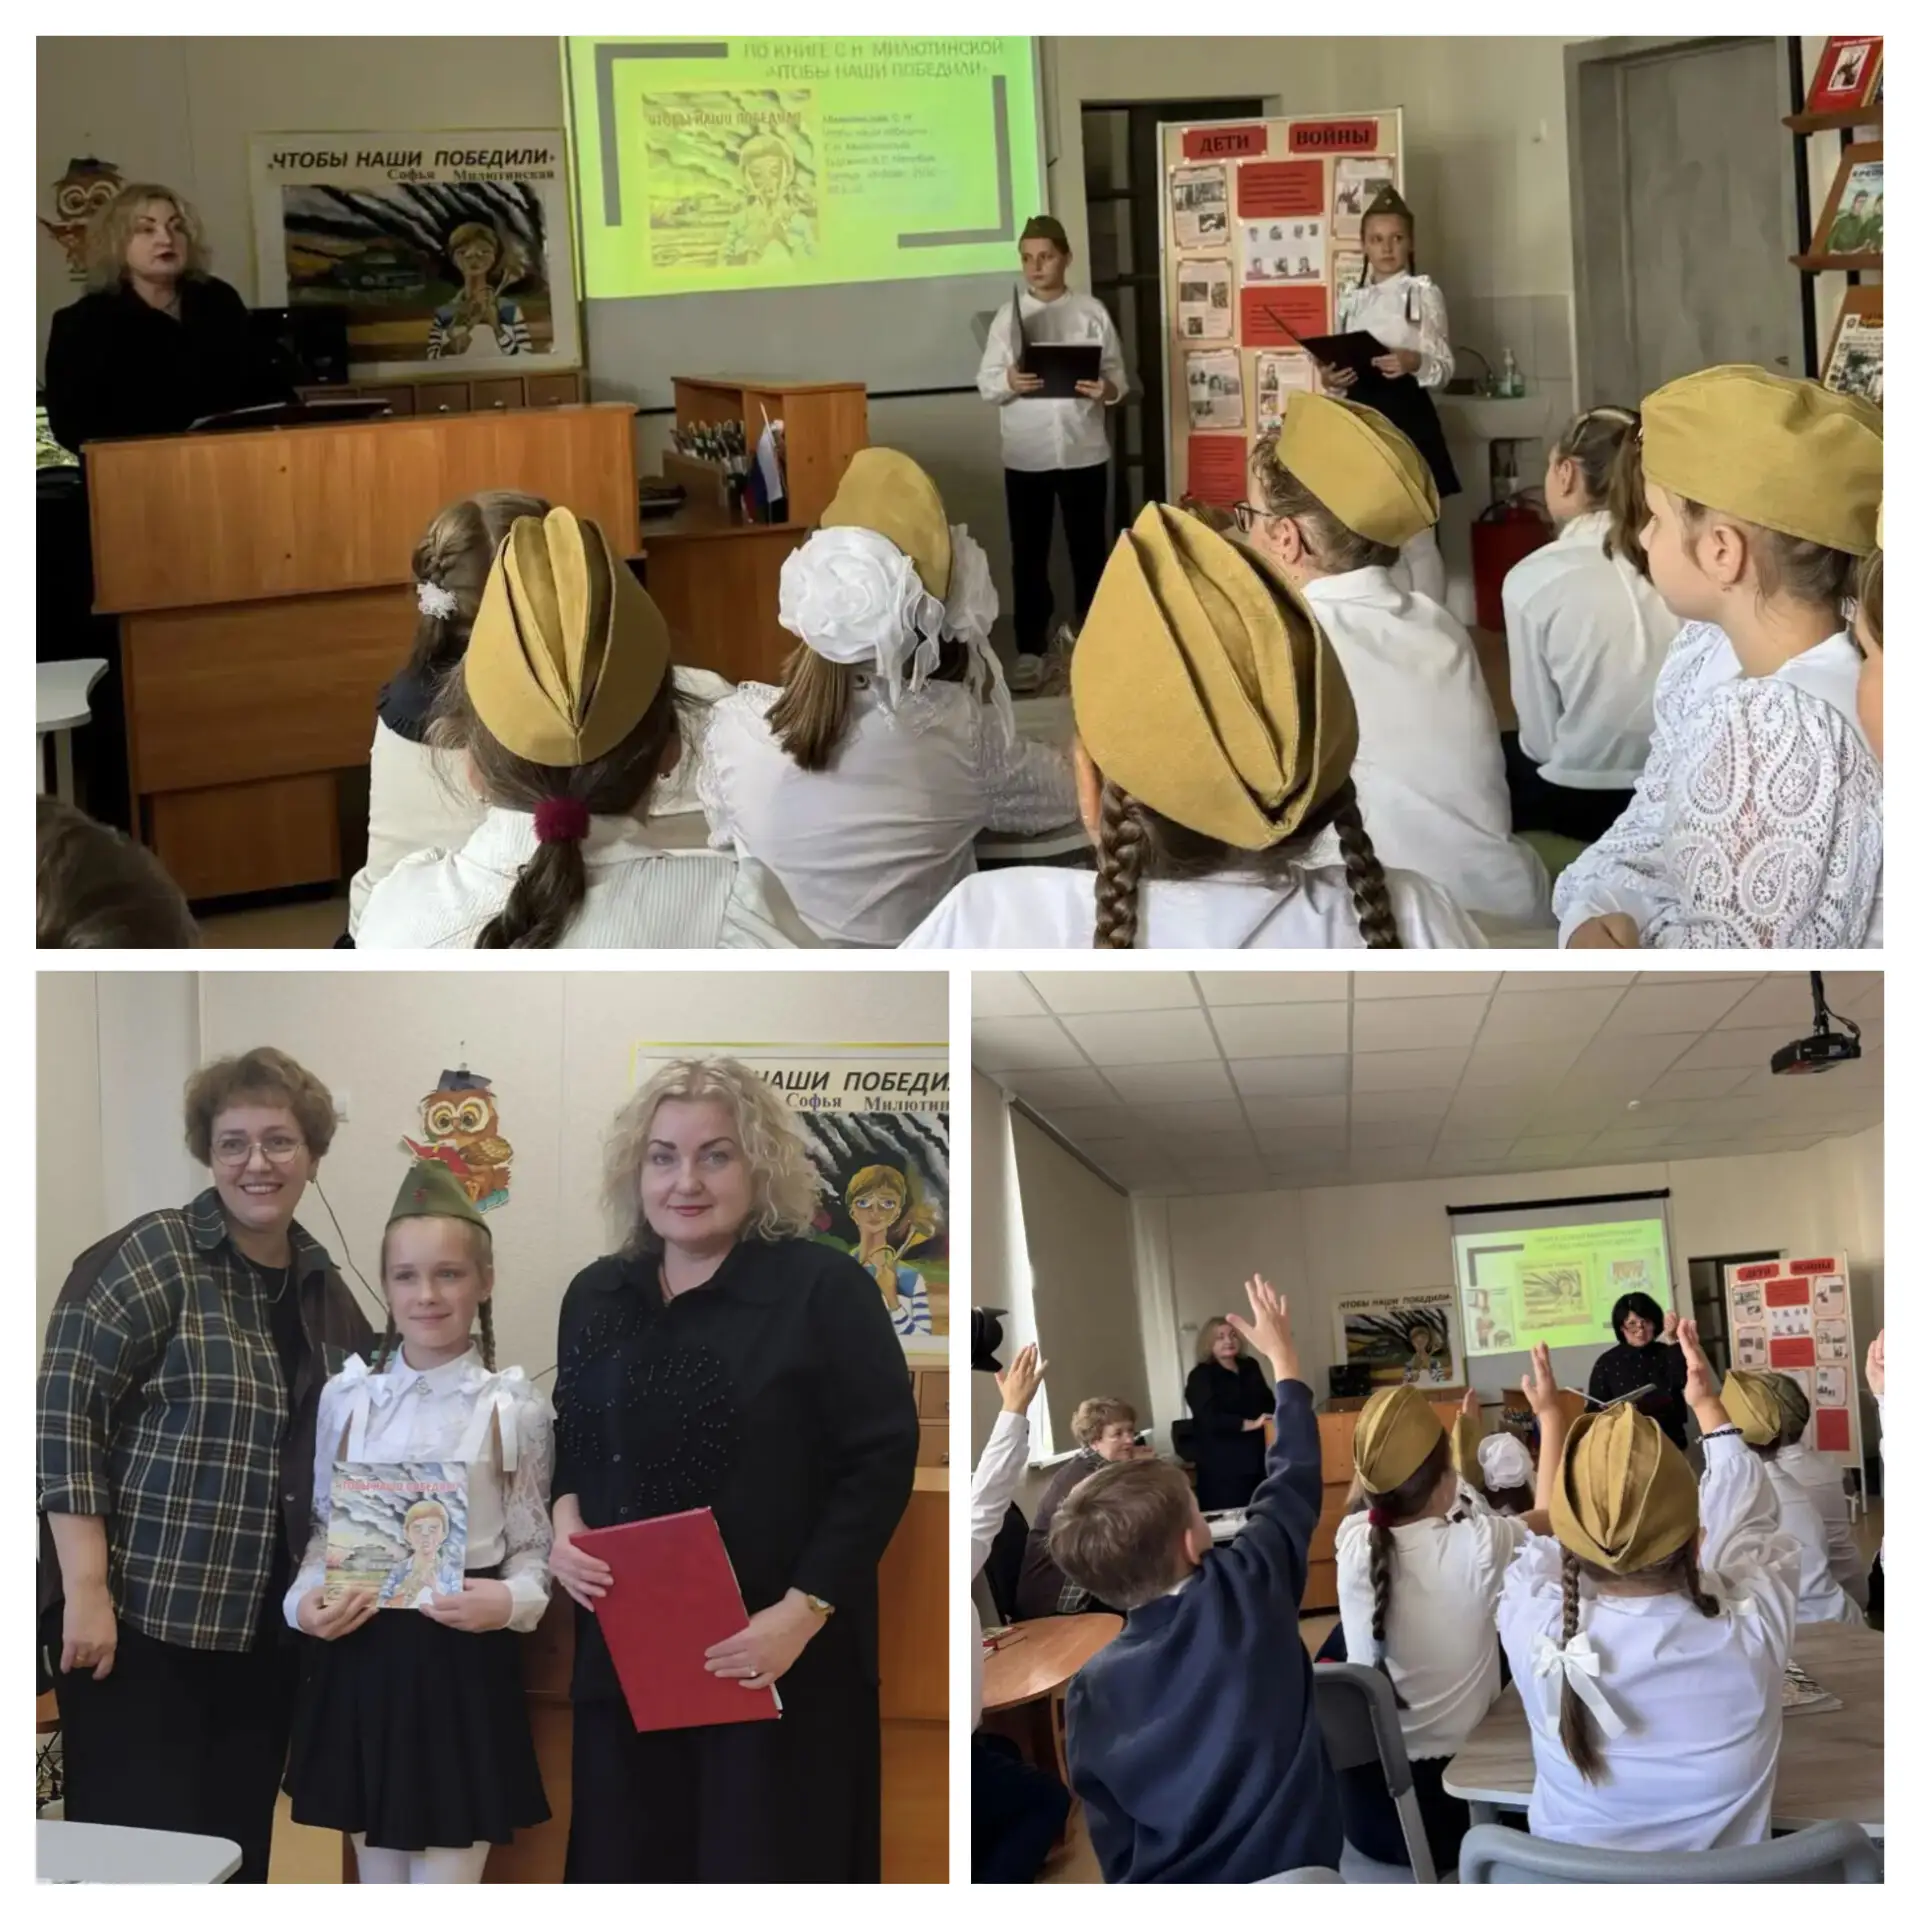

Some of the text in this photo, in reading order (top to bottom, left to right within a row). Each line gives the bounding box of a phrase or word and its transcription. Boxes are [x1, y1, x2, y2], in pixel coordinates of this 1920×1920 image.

[1199, 127, 1370, 154] ДЕТИ ВОЙНЫ
[355, 151, 421, 168] НАШИ
[387, 168, 435, 182] Софья
[844, 1071, 949, 1096] ПОБЕДИ
[786, 1092, 842, 1111] Софья
